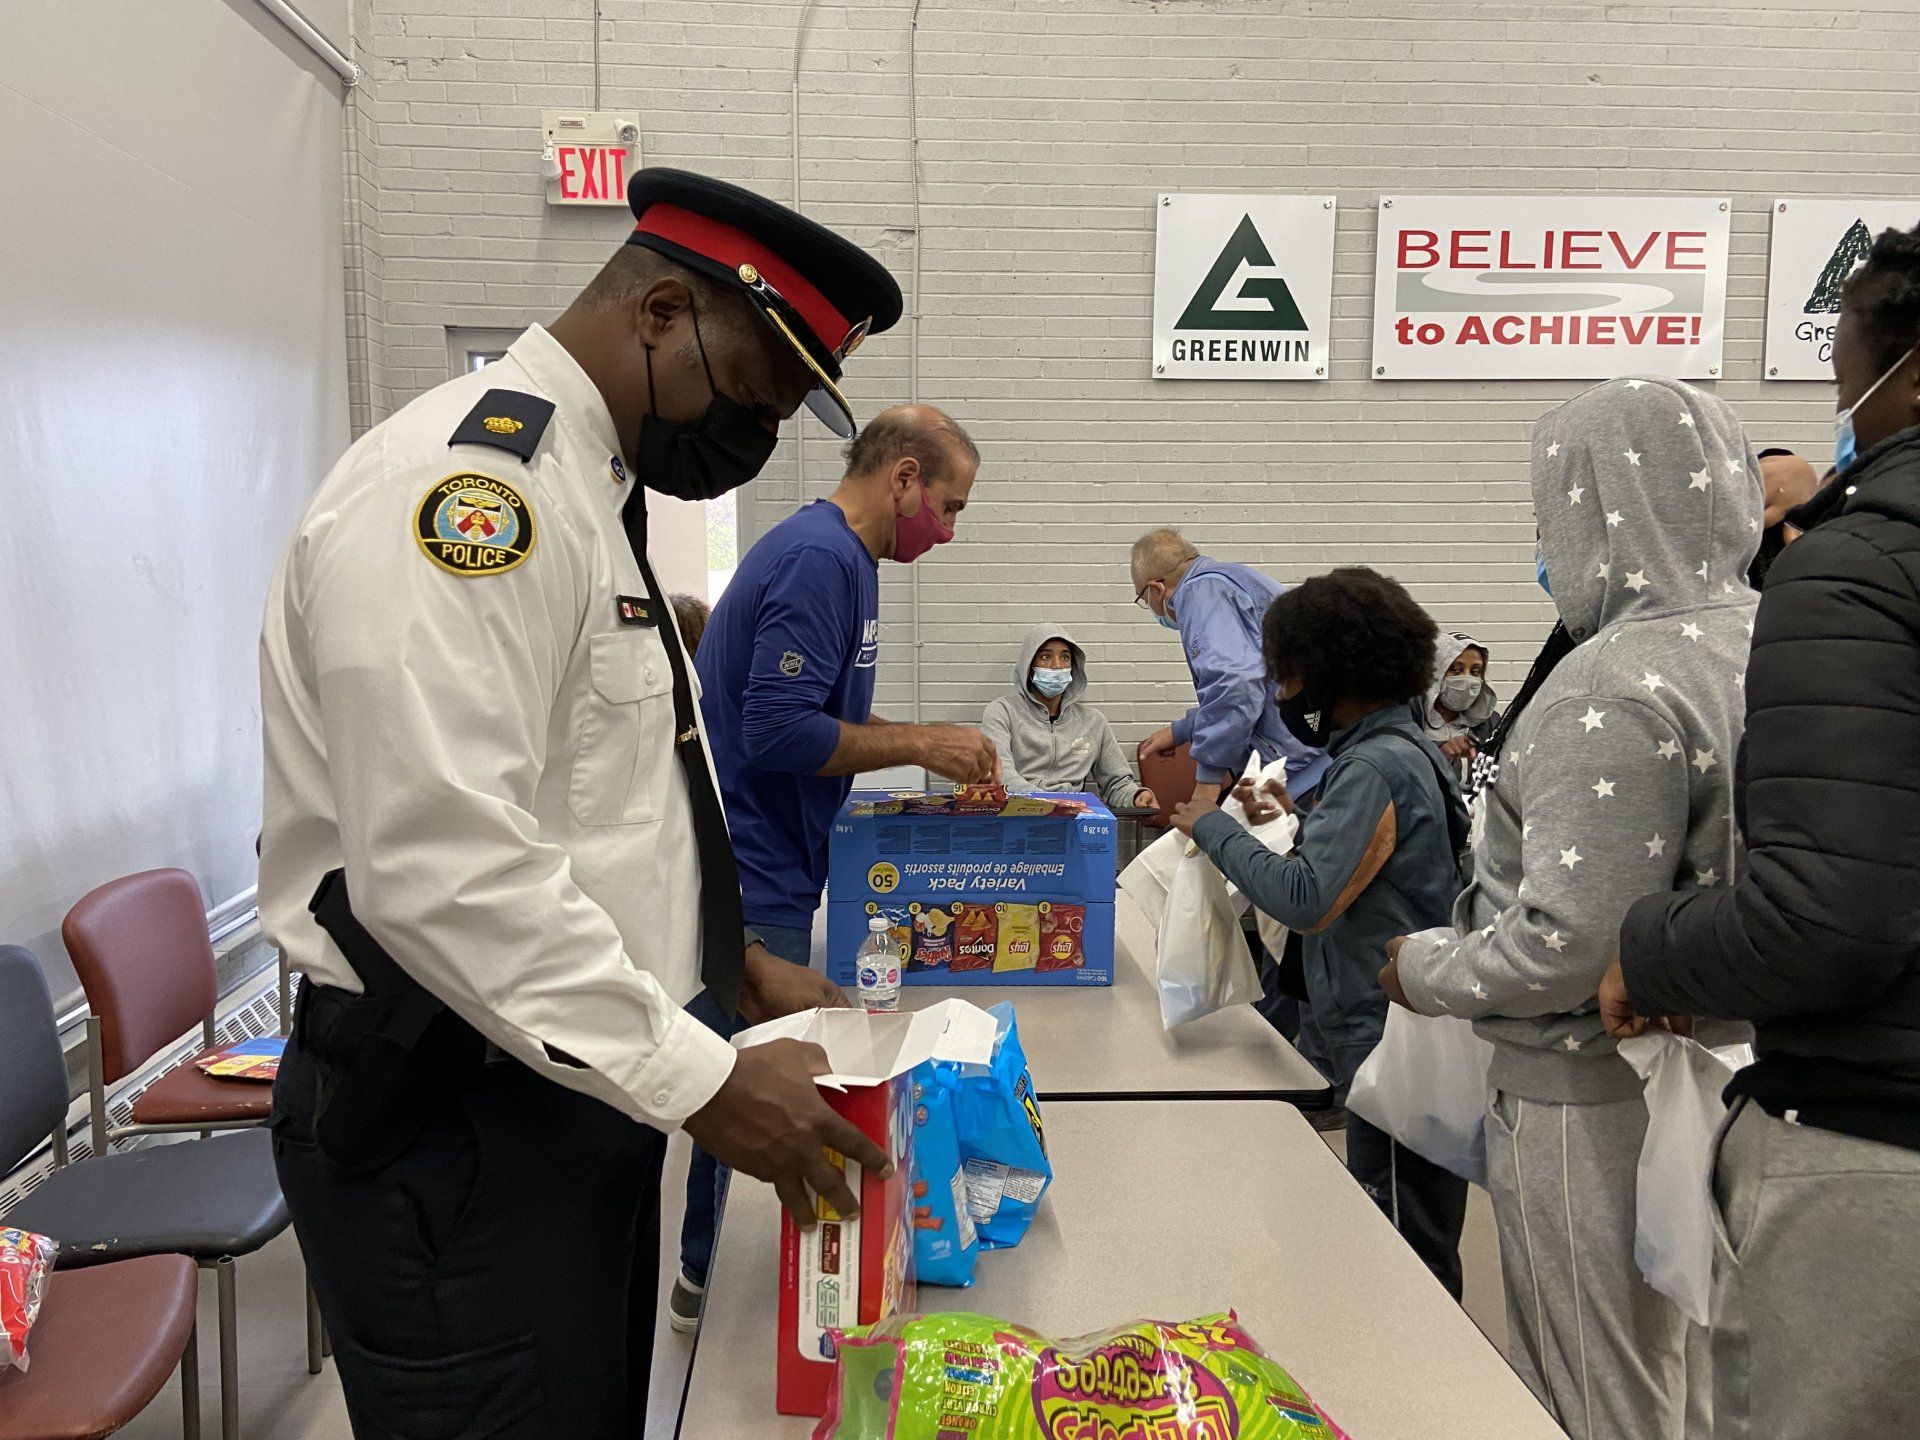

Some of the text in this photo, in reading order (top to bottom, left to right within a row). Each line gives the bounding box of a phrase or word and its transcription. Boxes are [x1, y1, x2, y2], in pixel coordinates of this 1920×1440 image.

[559, 147, 627, 199] EXIT
[1397, 229, 1707, 270] BELIEVE
[1395, 316, 1701, 346] to ACHIEVE!
[1172, 338, 1310, 362] GREENWIN
[438, 477, 521, 509] TORONTO
[441, 544, 507, 568] POLICE
[904, 863, 945, 876] assortis
[947, 862, 993, 876] produits
[994, 863, 1008, 876] de
[1010, 862, 1065, 876] Emballage
[872, 873, 893, 888] 50
[928, 876, 1026, 891] Variety Pack
[953, 904, 962, 912] 16
[1041, 904, 1047, 912] 8
[959, 943, 994, 955] Doritos
[1176, 1323, 1236, 1345] 25
